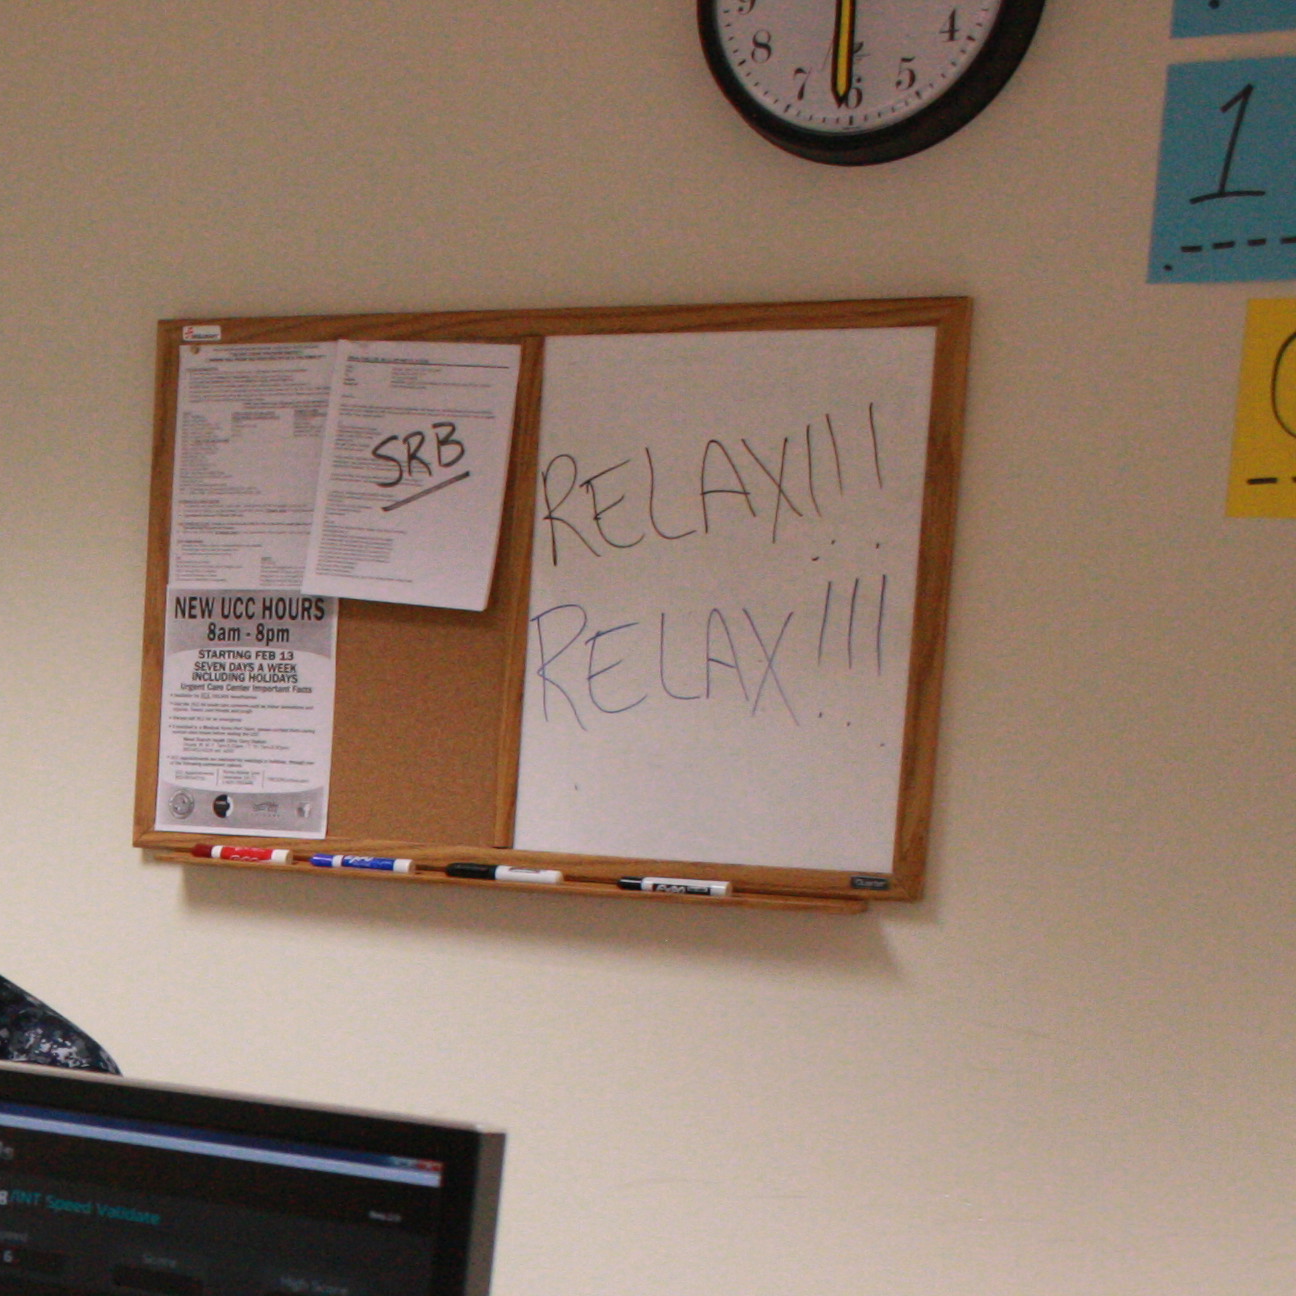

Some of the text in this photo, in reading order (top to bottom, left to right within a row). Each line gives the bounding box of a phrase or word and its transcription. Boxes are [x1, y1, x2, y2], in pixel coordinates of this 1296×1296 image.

[939, 9, 959, 42] 4
[751, 29, 772, 63] 8
[792, 66, 812, 101] 7
[895, 56, 916, 91] 5
[371, 421, 465, 488] SRB
[541, 402, 883, 567] RELAX!!!
[175, 596, 326, 621] NEW UCC HOURS
[207, 622, 241, 642] 8am
[256, 622, 290, 646] 8pm
[194, 661, 297, 674] SEVEN DAYS A WEEK
[198, 649, 295, 661] STARTING FEB 13
[530, 574, 887, 747] RELAX!!!
[192, 672, 298, 684] INCLUDING HOLIDAYS
[207, 683, 224, 692] Care
[226, 683, 250, 692] Center
[252, 684, 290, 694] Important
[45, 1194, 93, 1214] Speed
[95, 1202, 161, 1226] Validate
